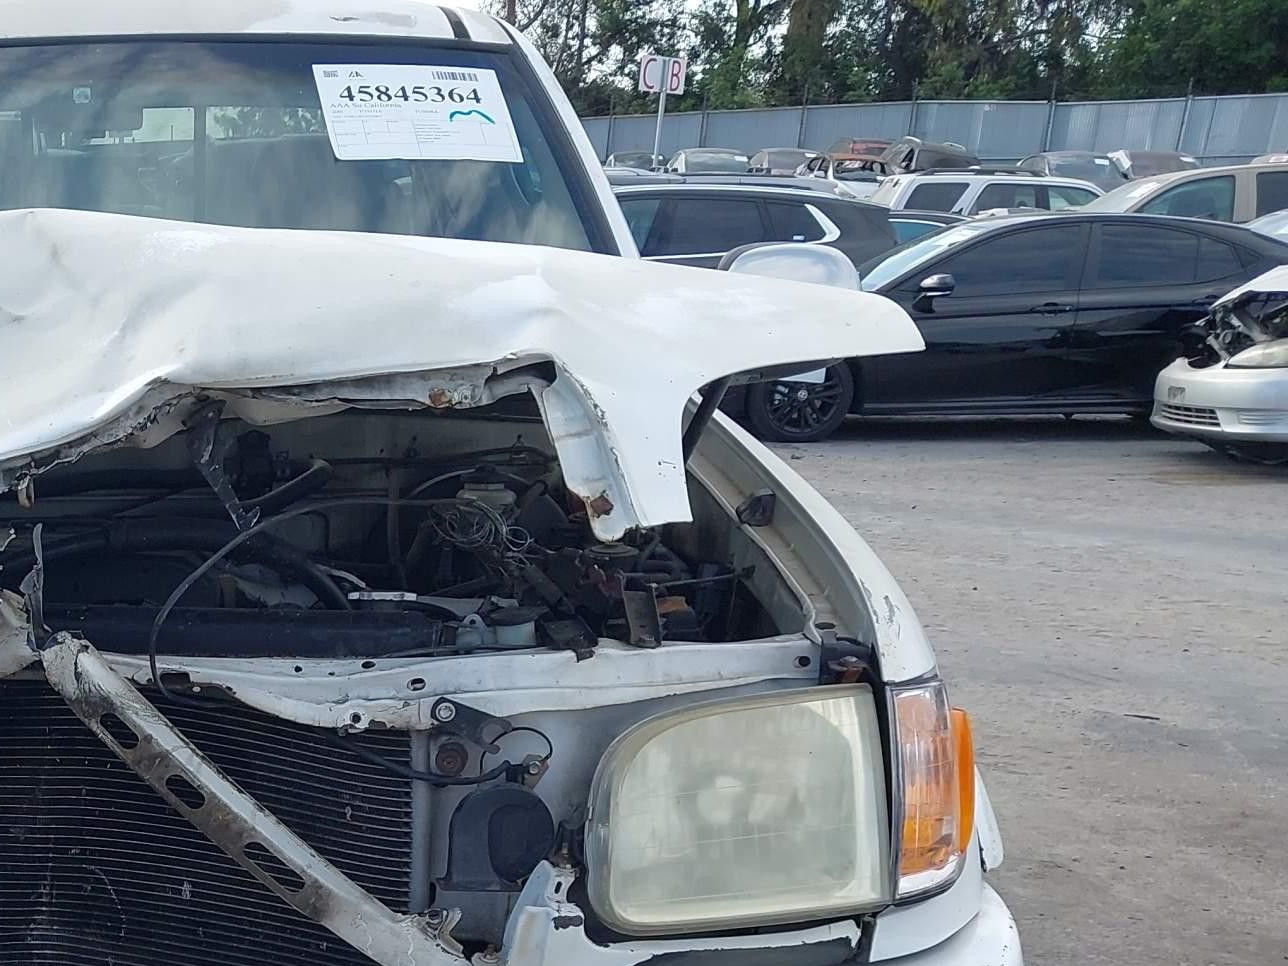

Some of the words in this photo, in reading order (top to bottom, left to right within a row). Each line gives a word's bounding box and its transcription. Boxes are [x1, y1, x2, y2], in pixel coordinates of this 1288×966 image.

[643, 57, 658, 90] C
[670, 60, 682, 92] B
[339, 85, 482, 104] 45845364
